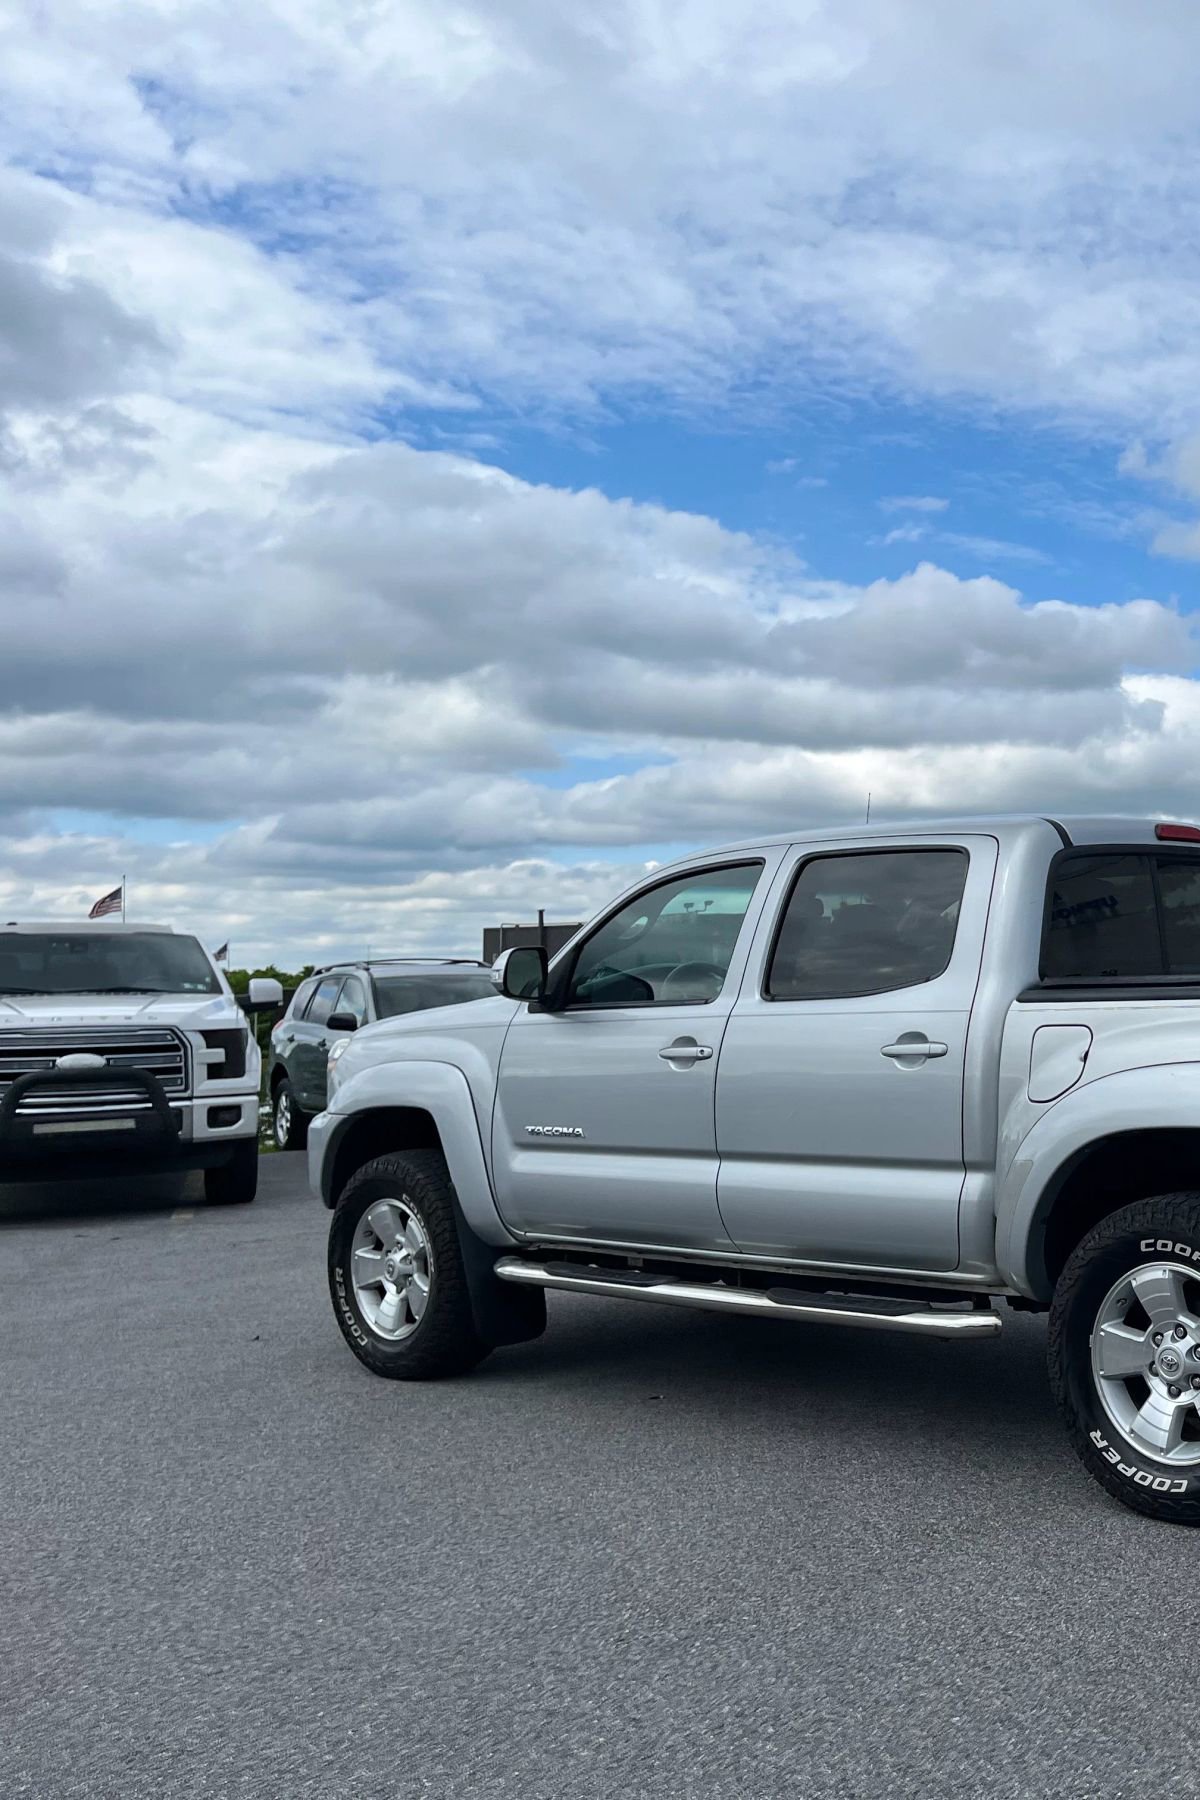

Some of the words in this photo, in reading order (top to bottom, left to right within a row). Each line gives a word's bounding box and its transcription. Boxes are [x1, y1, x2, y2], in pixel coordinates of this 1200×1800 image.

[525, 1125, 585, 1138] TACOMA
[335, 1267, 369, 1347] COOPER
[1089, 1429, 1188, 1493] COOPER
